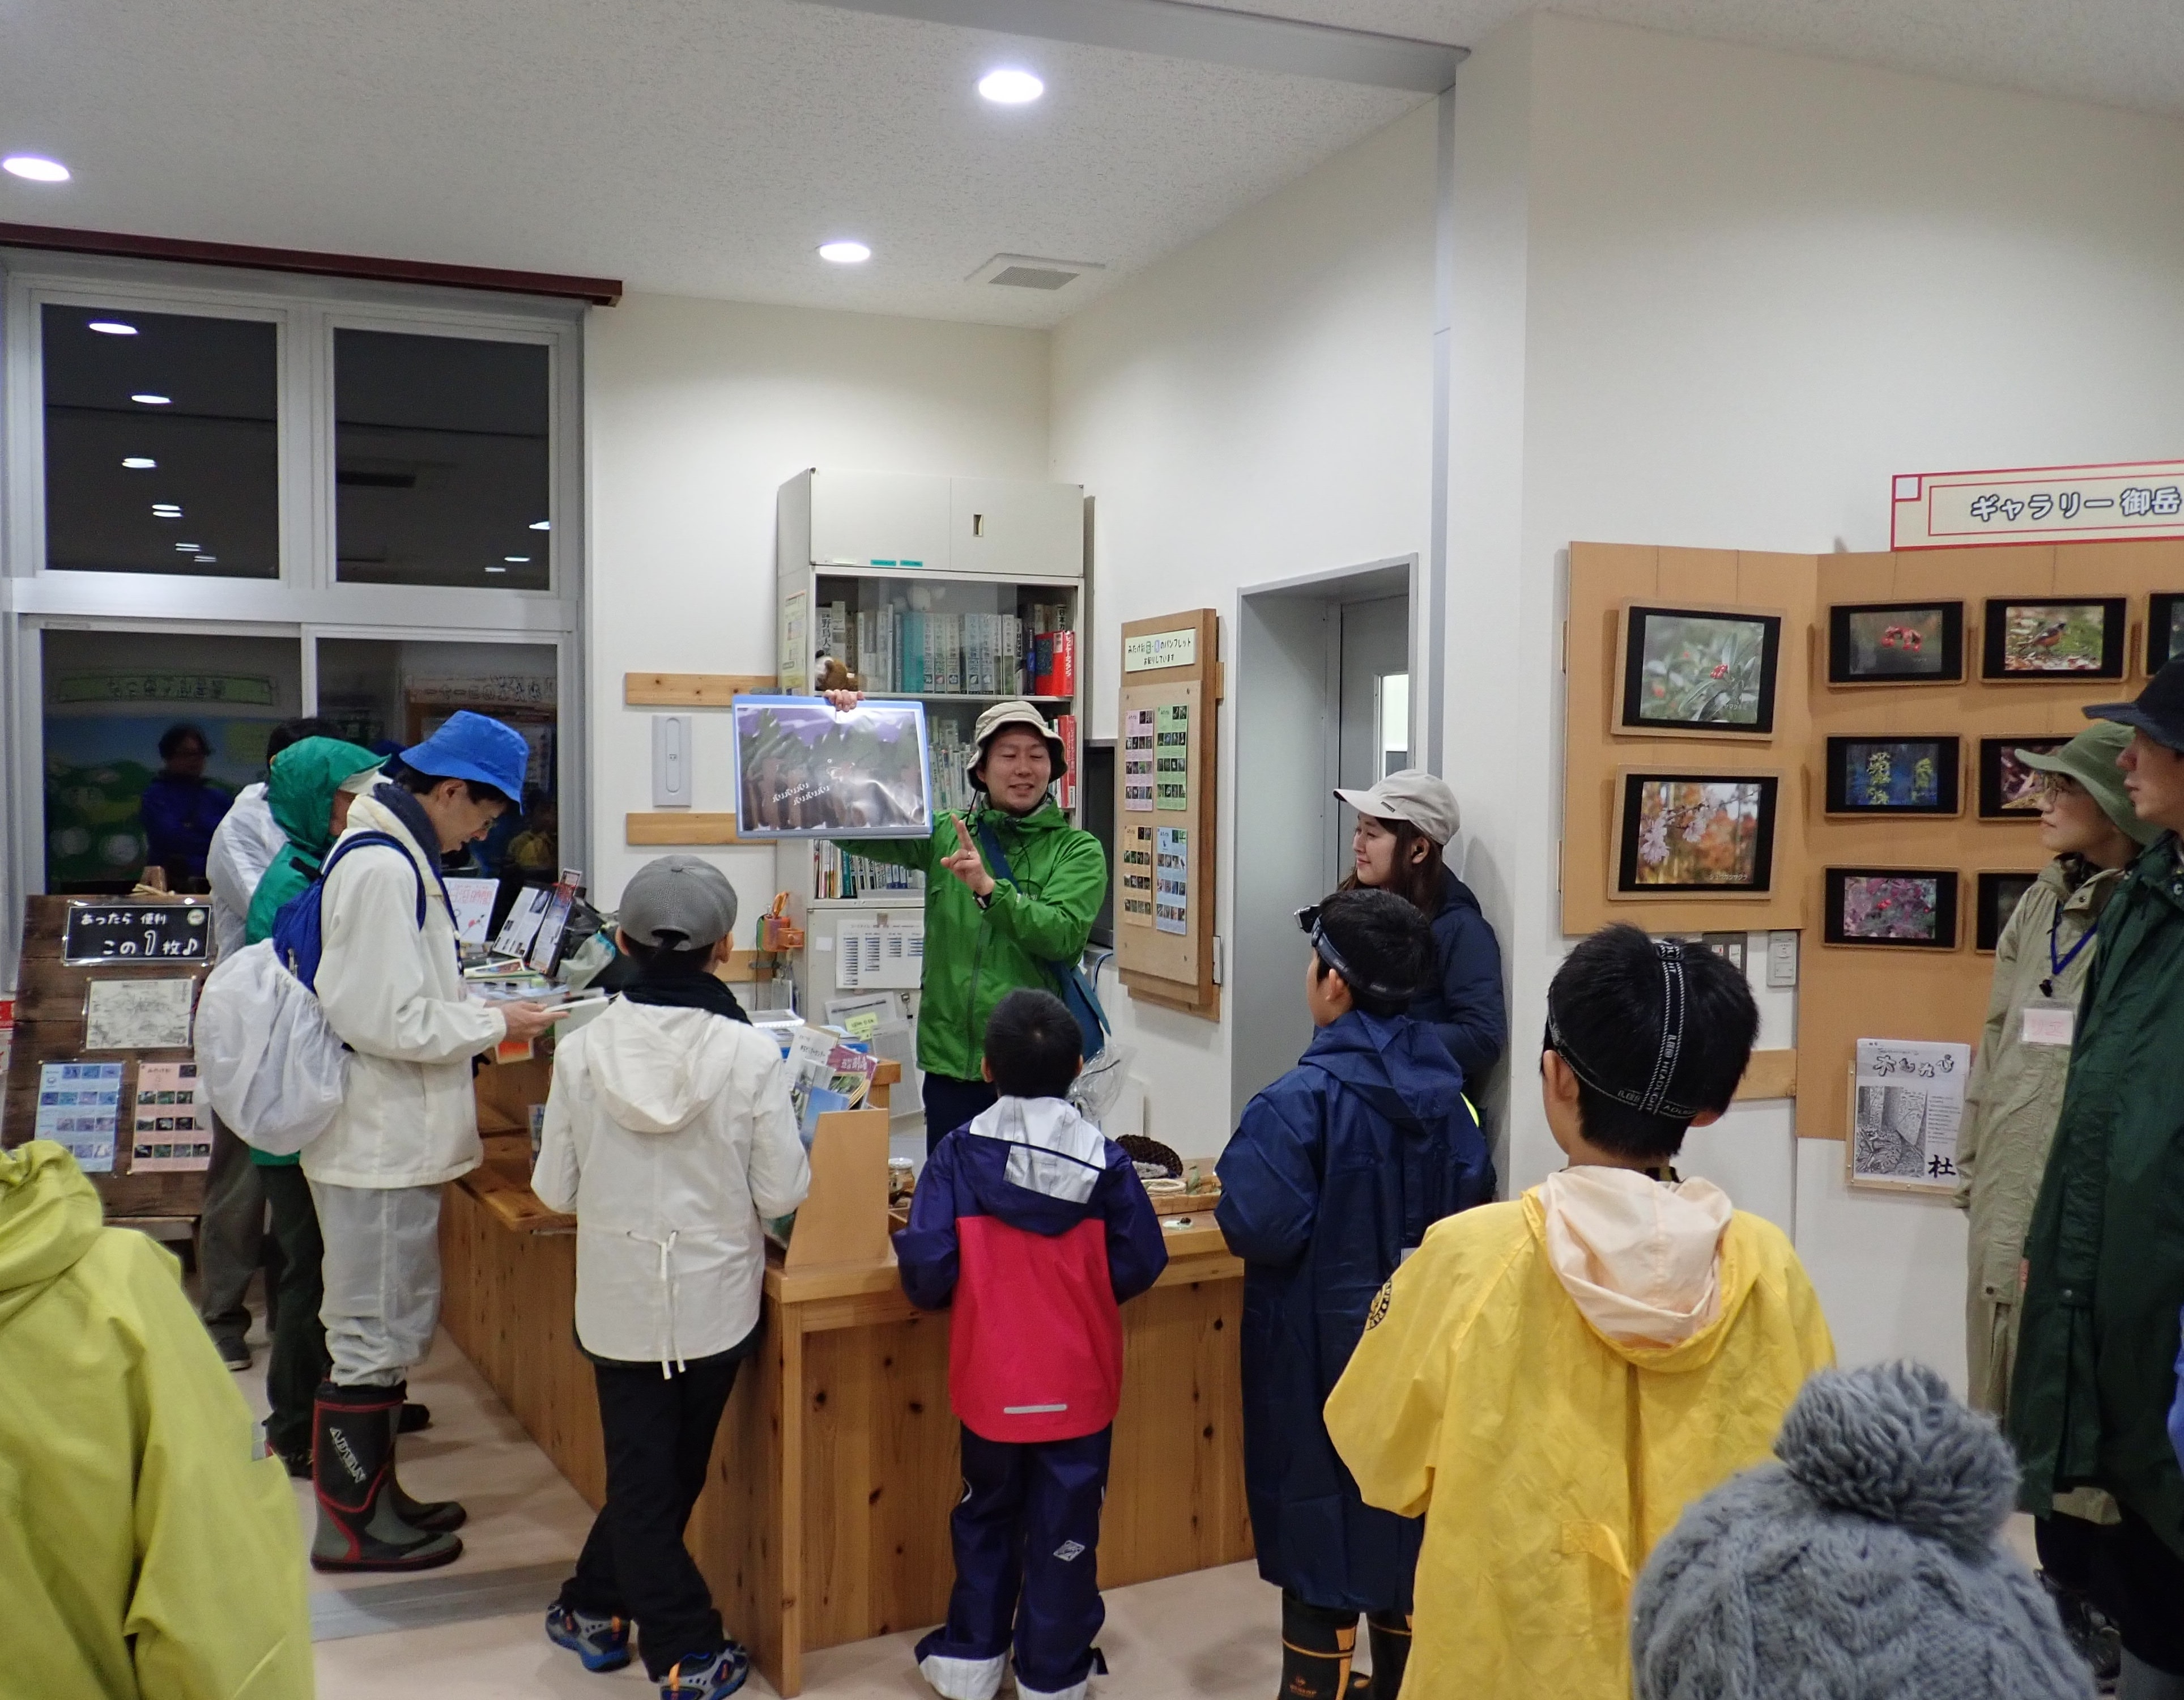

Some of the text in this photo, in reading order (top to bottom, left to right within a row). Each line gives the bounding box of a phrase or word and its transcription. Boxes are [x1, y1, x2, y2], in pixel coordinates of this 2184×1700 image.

[1971, 493, 2114, 521] ギャラリー
[81, 912, 167, 925] あったら 便利
